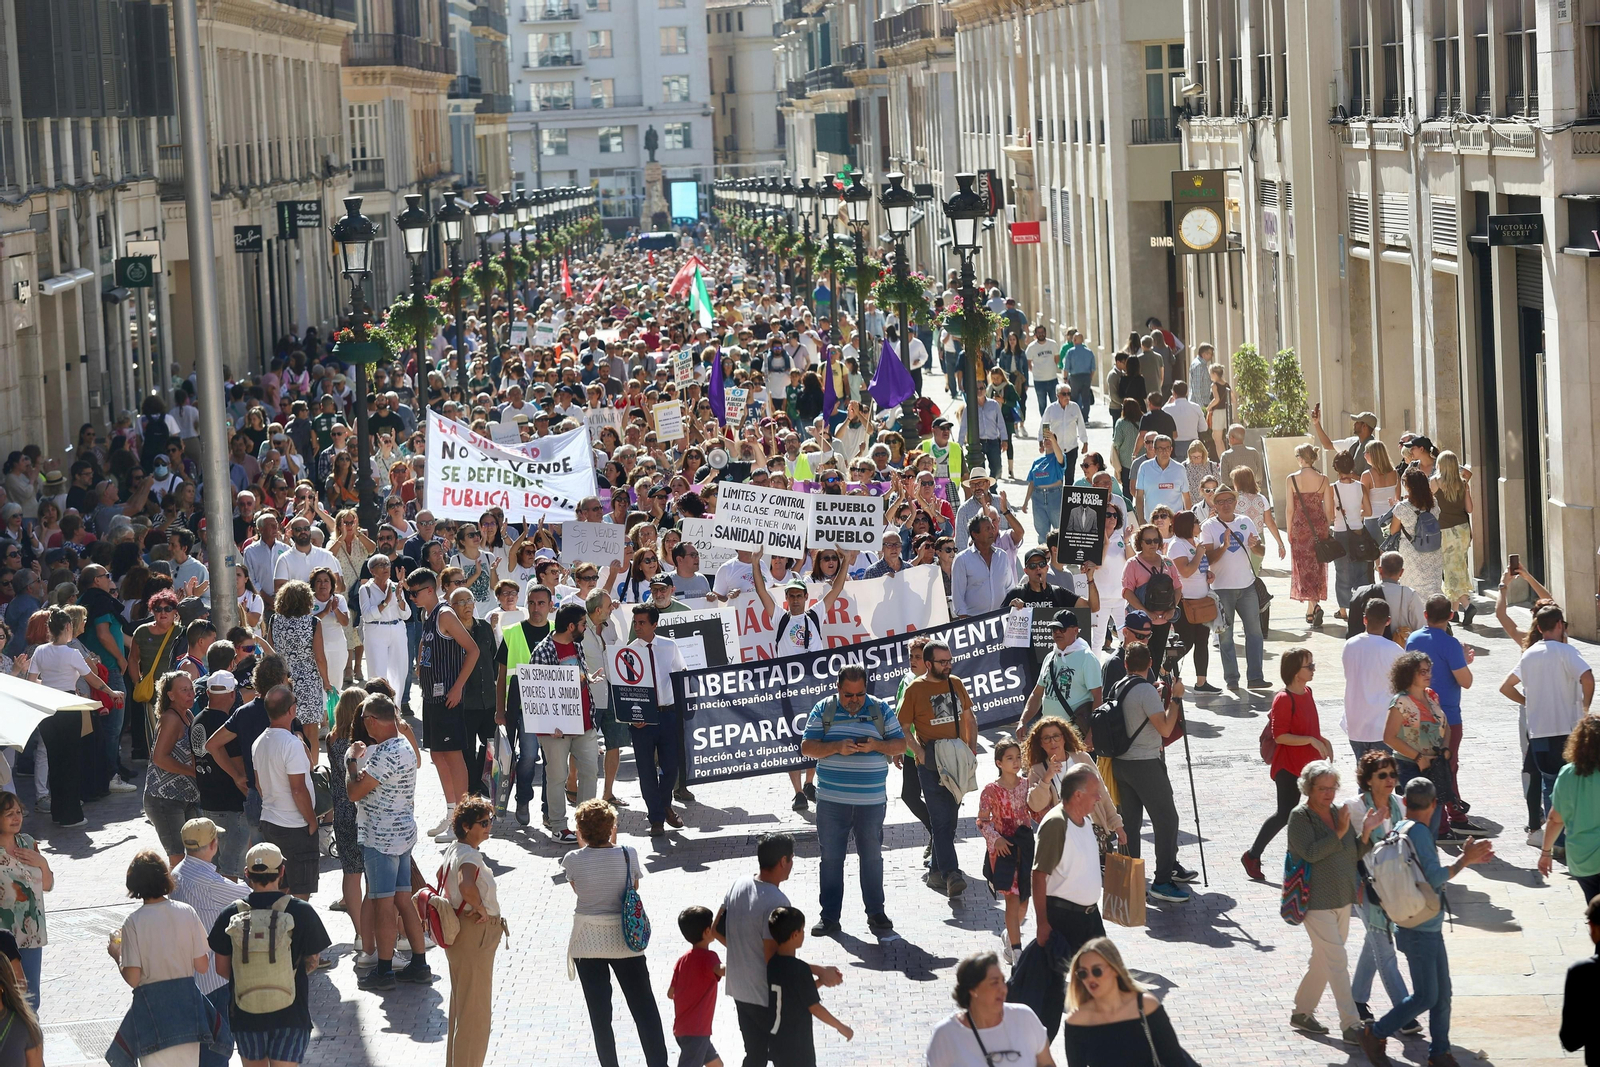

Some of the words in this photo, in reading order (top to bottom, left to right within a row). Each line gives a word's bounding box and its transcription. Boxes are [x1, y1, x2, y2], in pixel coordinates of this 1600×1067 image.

[1494, 223, 1538, 231] VICTORIA'S
[1150, 236, 1174, 248] BIMB
[441, 441, 469, 460] NO
[508, 456, 573, 475] VENDE
[441, 466, 461, 482] SE
[442, 487, 510, 510] PUBLICA
[722, 487, 756, 502] LÍMITES
[760, 493, 768, 503] Y
[769, 494, 806, 510] CONTROL
[1072, 491, 1081, 499] NO
[1082, 492, 1100, 500] VOTO
[1082, 498, 1103, 506] NADIE
[731, 503, 742, 512] LA
[743, 504, 770, 516] CLASE
[815, 502, 829, 512] EL
[830, 502, 876, 513] PUEBLO
[730, 515, 752, 525] PARA
[754, 518, 779, 530] TENER
[781, 521, 797, 531] UNA
[816, 515, 858, 526] SALVA
[859, 516, 875, 527] AL
[572, 525, 587, 539] SE
[593, 526, 618, 539] VENDE
[689, 525, 704, 538] LA
[815, 530, 875, 544] PUEBLO
[575, 541, 588, 555] TU
[592, 541, 621, 555] SALUD
[567, 669, 575, 682] DE
[684, 661, 806, 699] LIBERTAD
[687, 702, 699, 711] La
[700, 697, 731, 710] nación
[732, 693, 774, 709] española
[775, 687, 799, 699] debe
[800, 682, 828, 696] elegir
[869, 672, 881, 682] de
[972, 647, 985, 657] de
[521, 686, 546, 699] PODERES
[549, 686, 556, 699] LA
[552, 702, 560, 716] SE
[561, 703, 581, 717] MUERE
[693, 750, 733, 765] Elección
[735, 748, 747, 759] de
[749, 749, 754, 758] 1
[756, 743, 800, 756] diputado
[983, 693, 1026, 712] gobierno
[695, 768, 711, 778] Por
[713, 762, 751, 776] mayoría
[753, 762, 759, 770] a
[761, 757, 788, 768] doble
